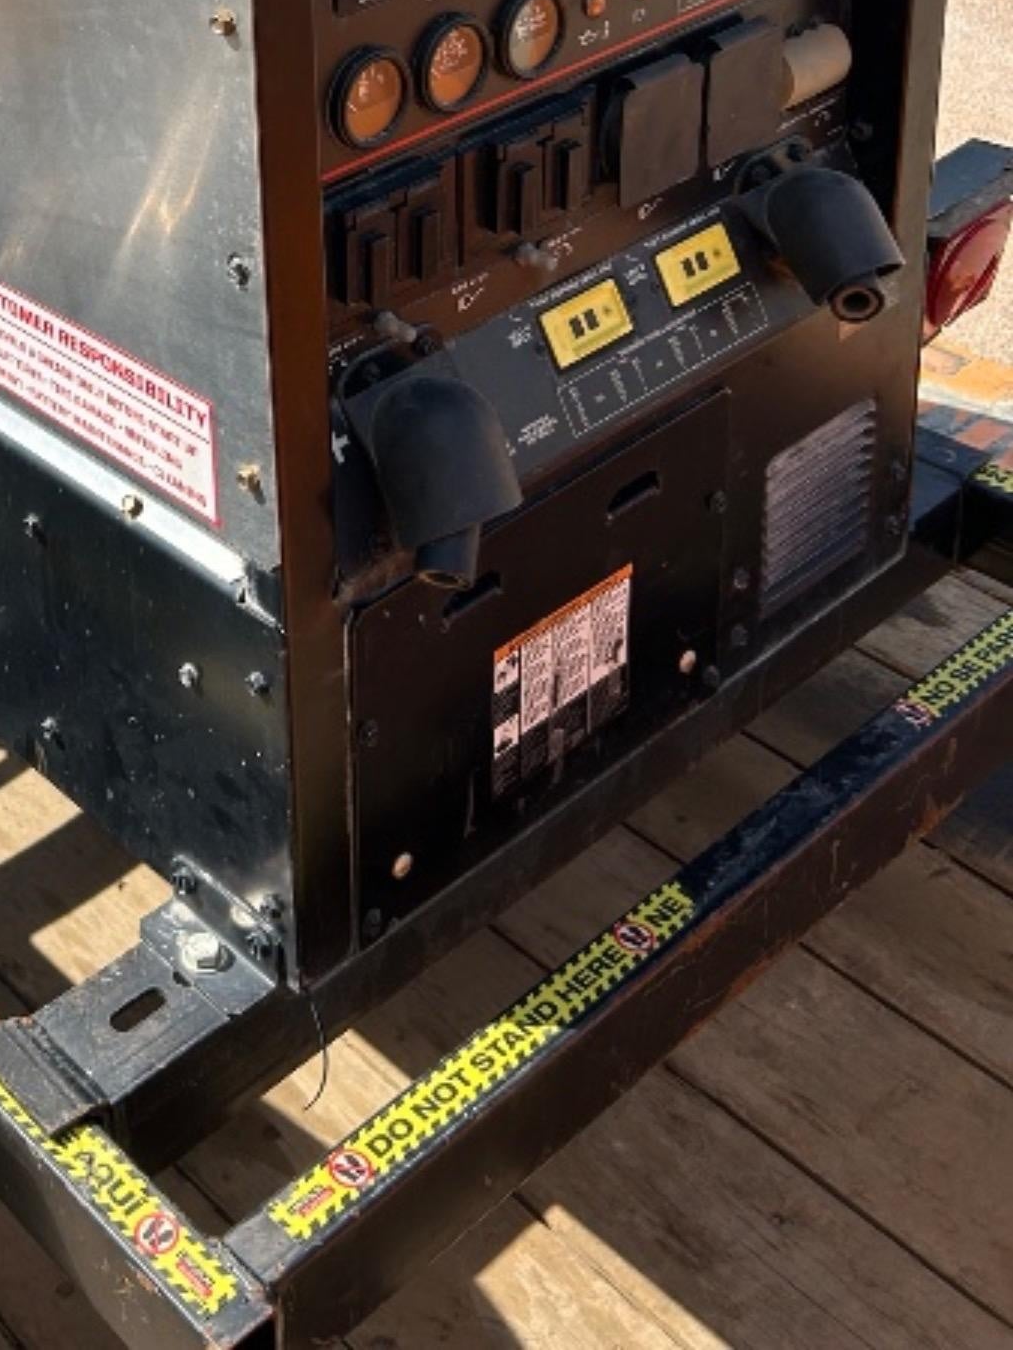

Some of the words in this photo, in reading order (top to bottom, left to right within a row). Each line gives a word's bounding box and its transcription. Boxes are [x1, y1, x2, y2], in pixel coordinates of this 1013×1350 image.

[58, 328, 207, 427] RESPONSIBILITY
[644, 896, 685, 928] NE
[364, 1117, 414, 1159] DO
[409, 1066, 472, 1121] NOT
[469, 1000, 559, 1072] STAND
[554, 943, 628, 1003] HERE
